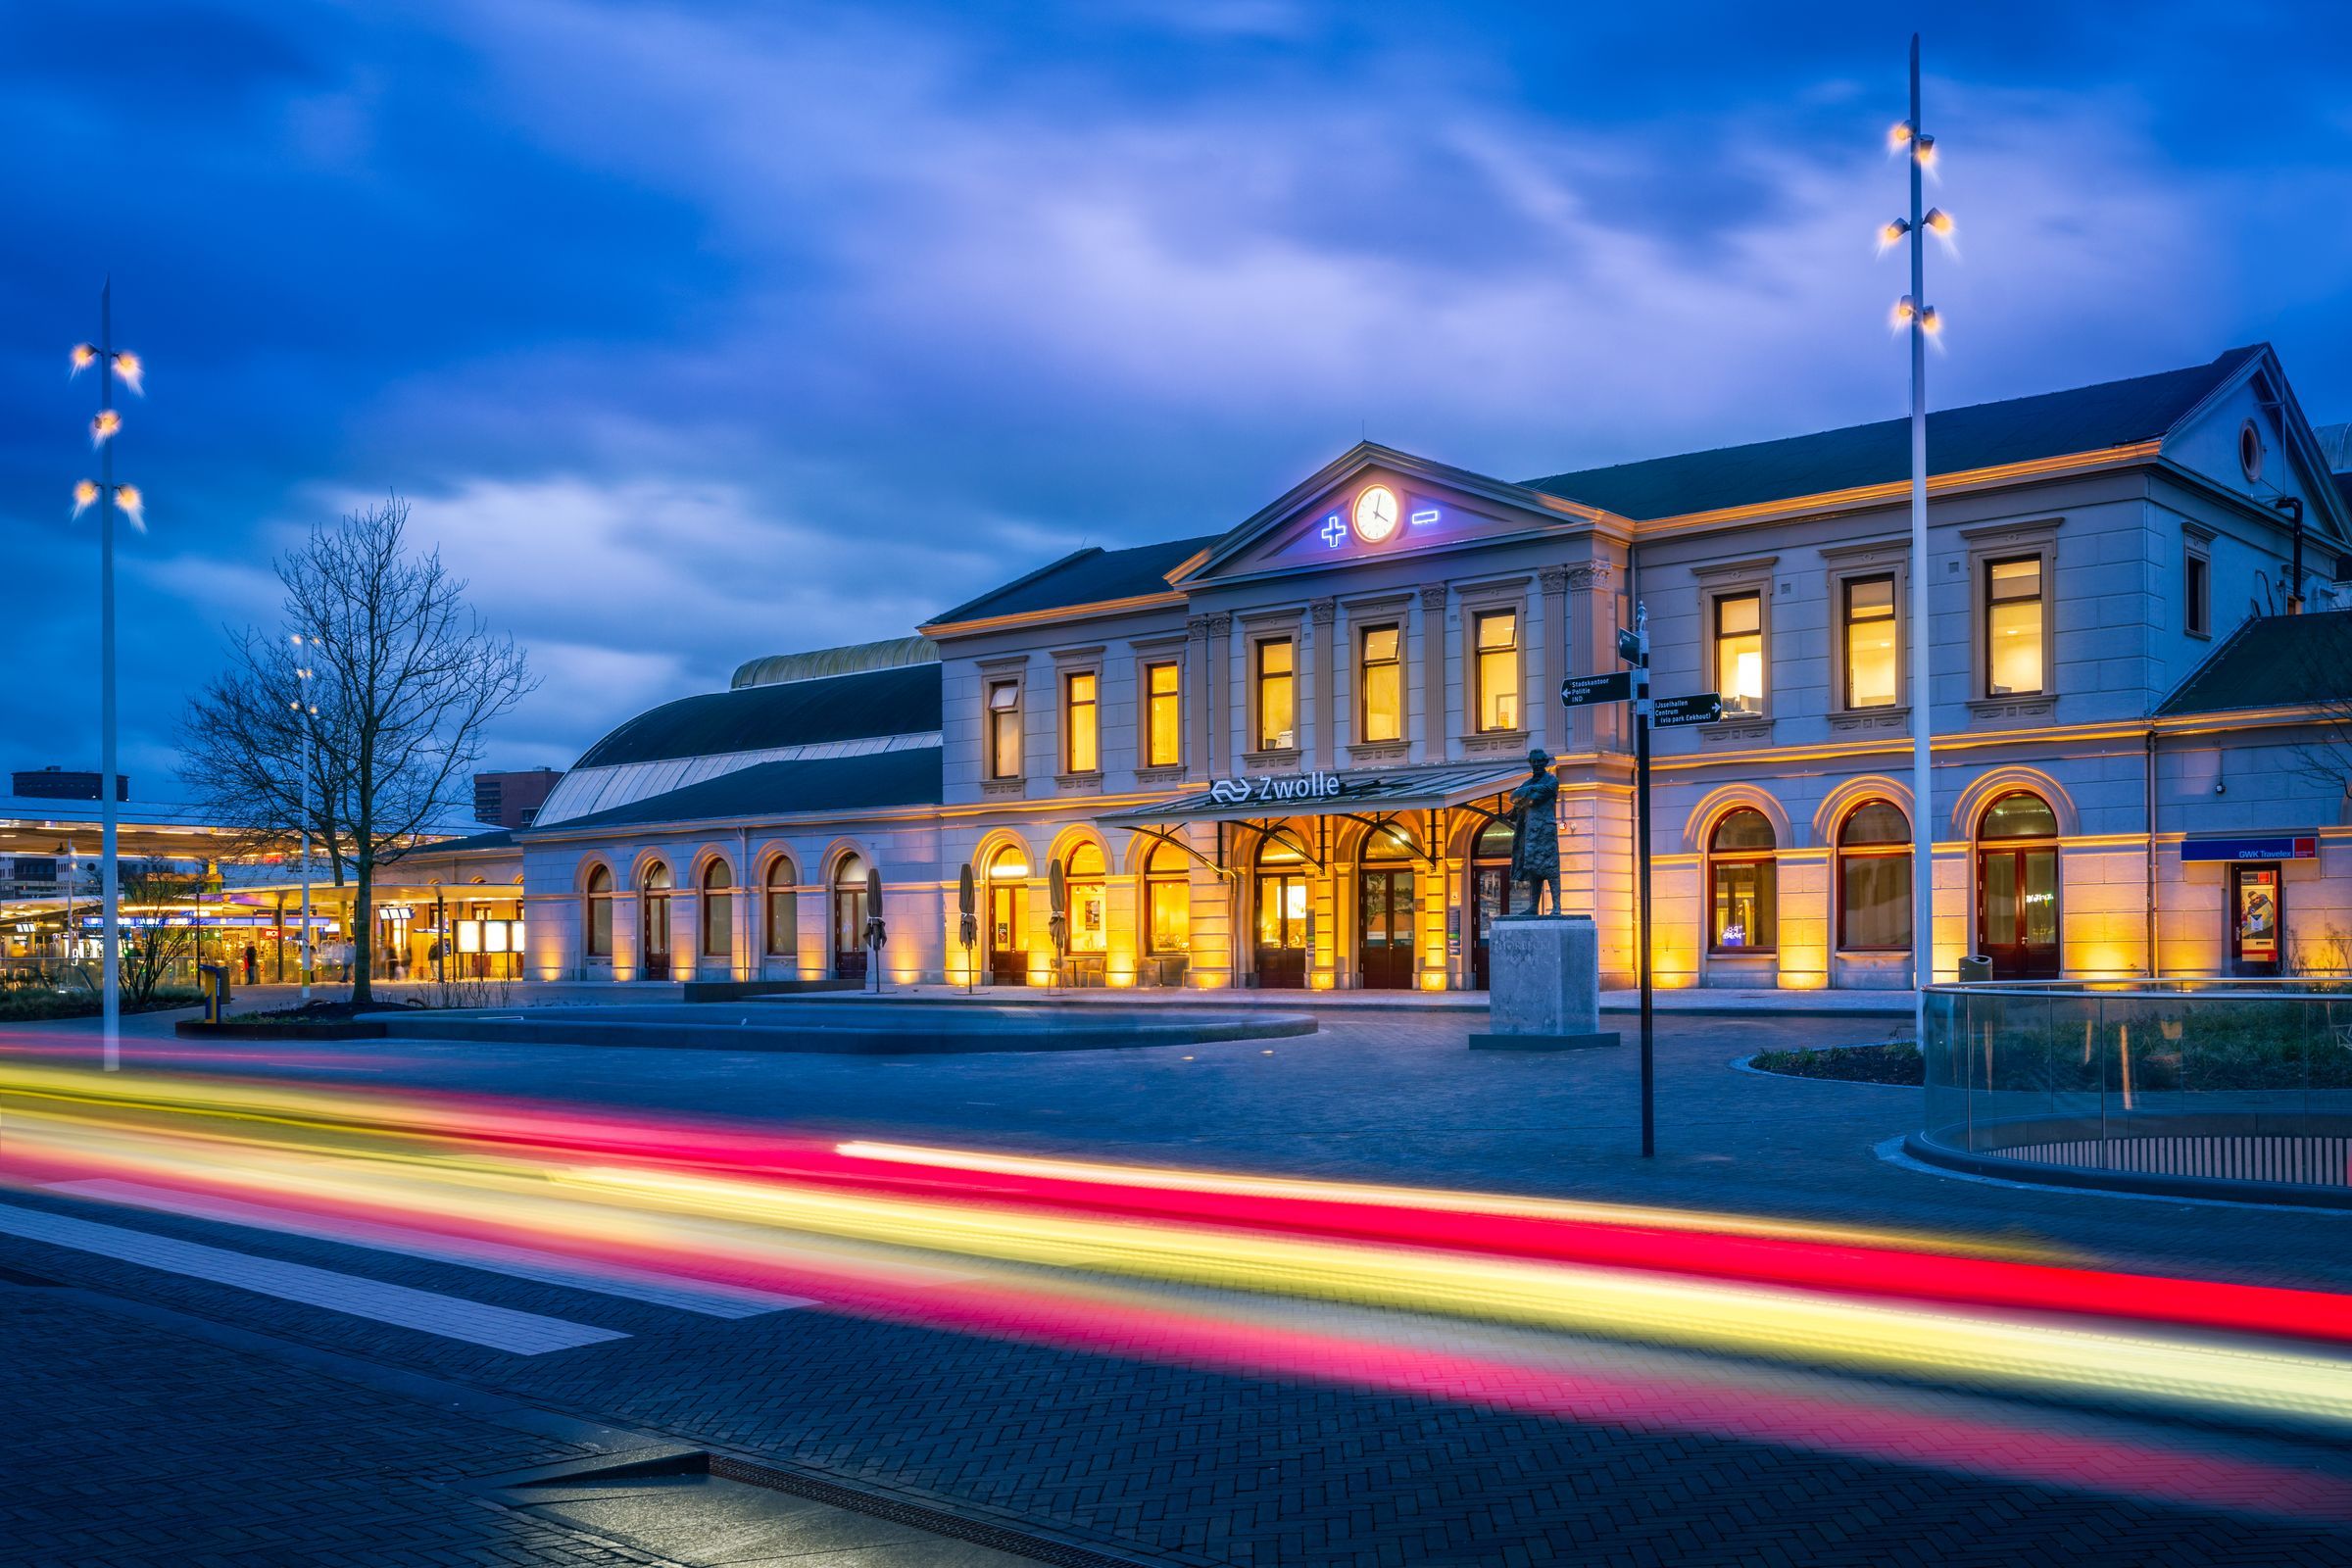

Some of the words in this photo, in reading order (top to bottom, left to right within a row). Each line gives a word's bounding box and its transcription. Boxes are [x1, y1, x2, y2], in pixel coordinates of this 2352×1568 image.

[1572, 678, 1609, 688] Stadskantoor
[1655, 700, 1689, 709] IJsselhallen
[1686, 712, 1711, 721] Eekhout)
[1259, 770, 1340, 801] Zwolle
